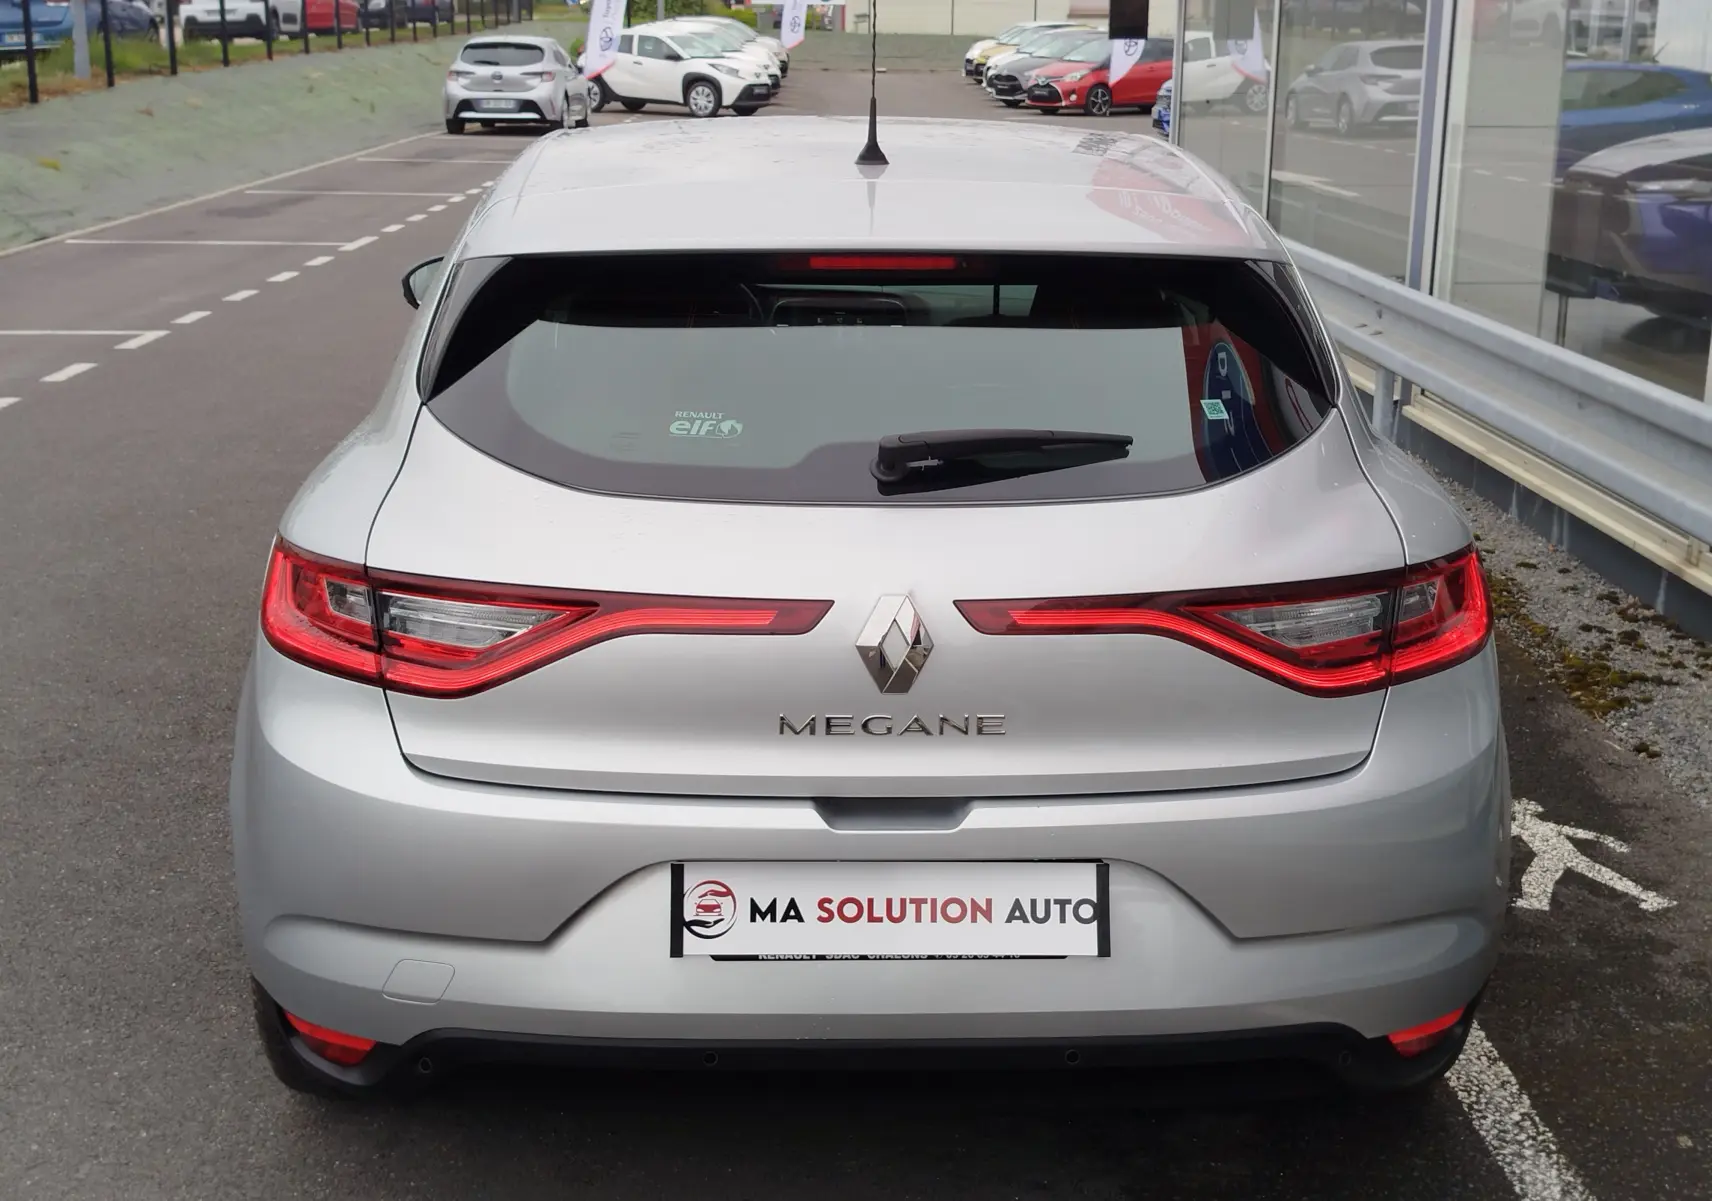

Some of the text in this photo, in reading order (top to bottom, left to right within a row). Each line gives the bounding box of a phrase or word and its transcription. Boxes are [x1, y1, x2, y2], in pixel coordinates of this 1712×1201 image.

[674, 410, 725, 419] RENAULT
[669, 419, 717, 435] elf
[778, 713, 1006, 736] MEGANE
[749, 896, 1099, 925] MA SOLUTION AUTO
